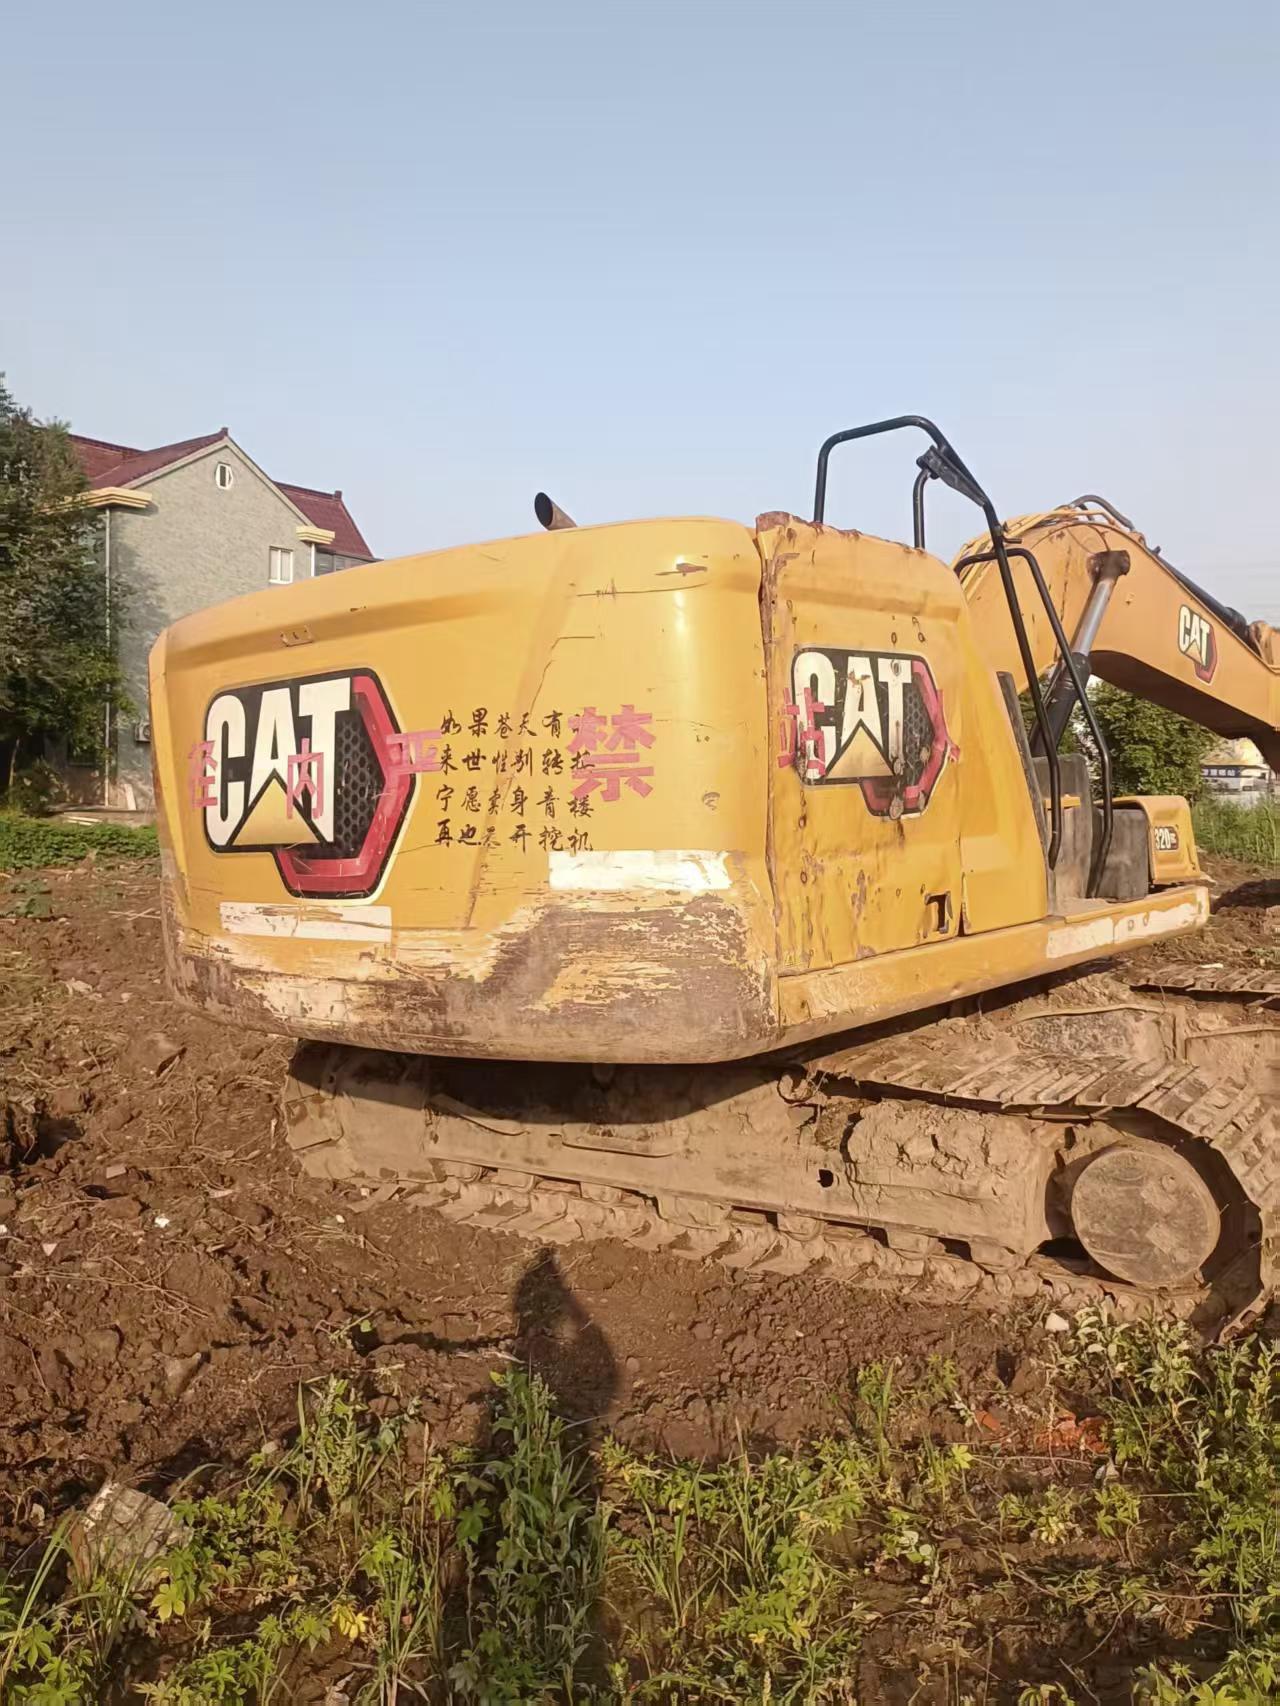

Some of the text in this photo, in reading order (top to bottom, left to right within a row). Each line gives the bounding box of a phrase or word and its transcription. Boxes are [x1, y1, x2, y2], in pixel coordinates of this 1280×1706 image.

[1179, 606, 1211, 667] CAT
[206, 677, 350, 847] CAT
[287, 738, 324, 819] 内
[566, 705, 656, 802] 禁
[793, 651, 912, 779] CAT
